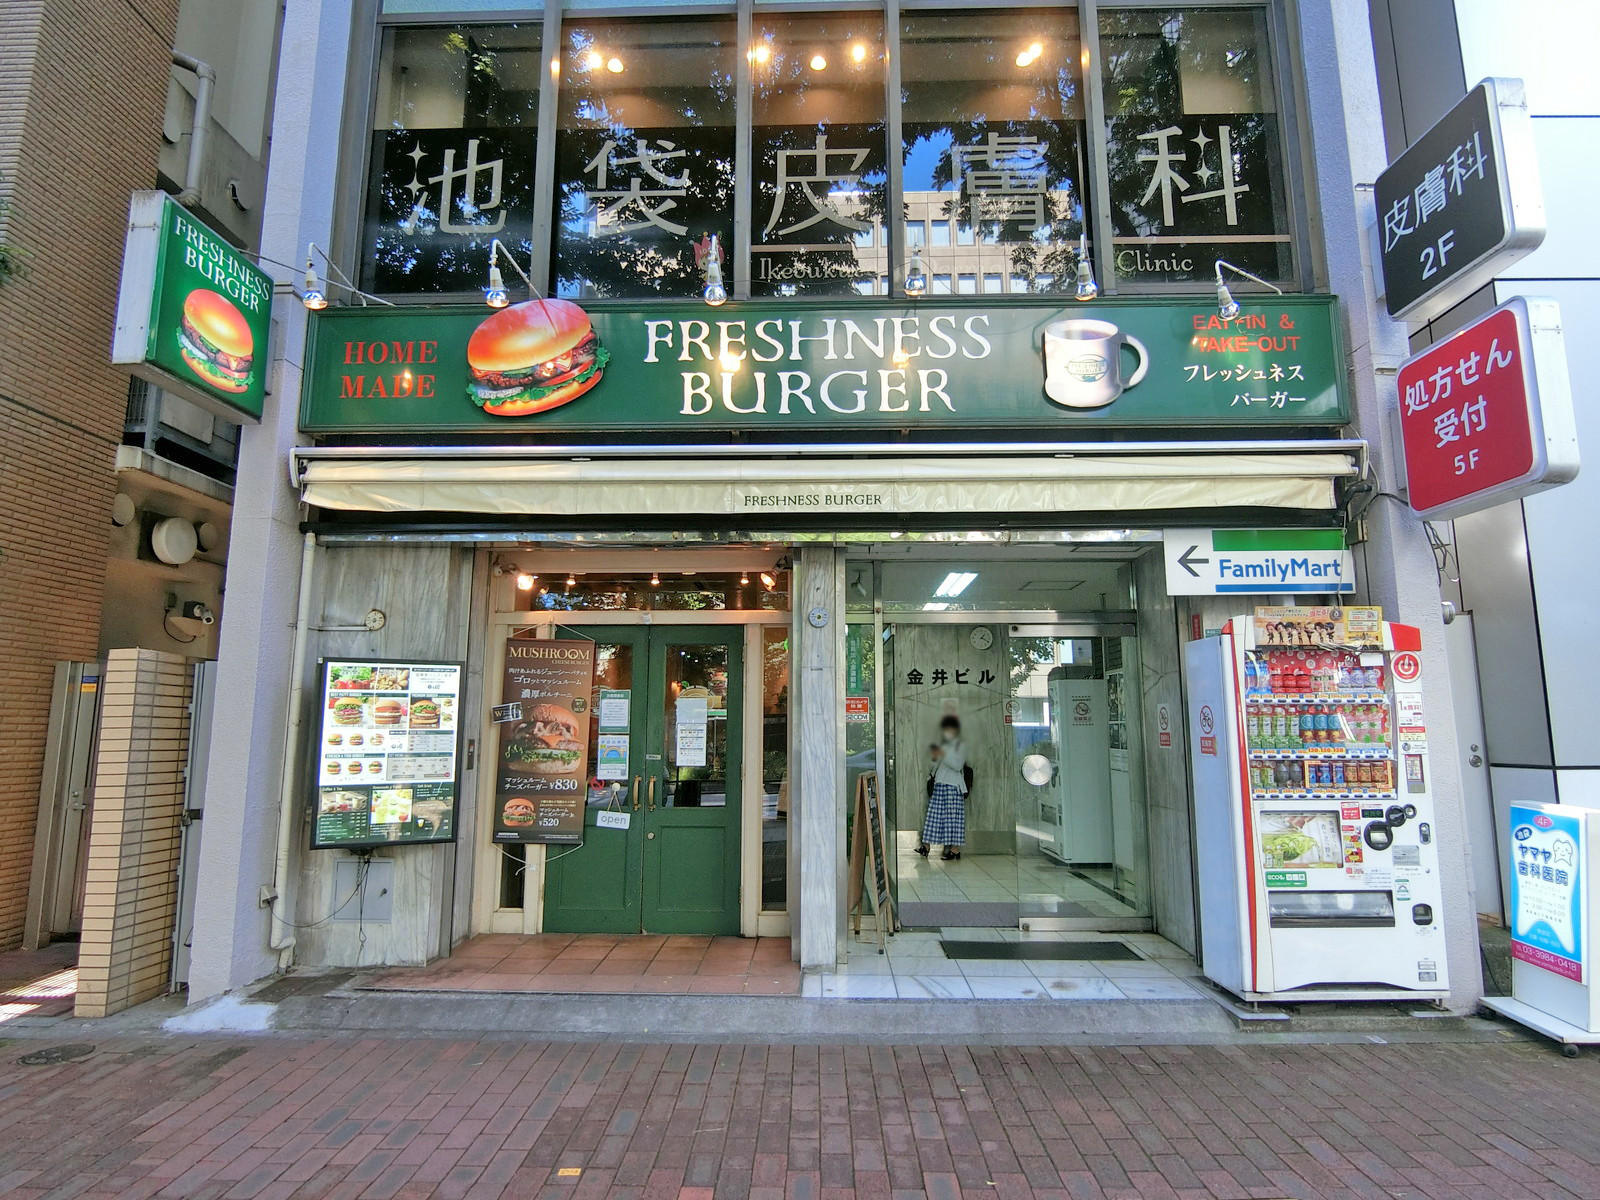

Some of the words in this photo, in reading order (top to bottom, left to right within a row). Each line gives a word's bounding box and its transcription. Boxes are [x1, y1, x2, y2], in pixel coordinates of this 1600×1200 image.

[407, 126, 1250, 236] 池袋皮膚科
[1384, 131, 1488, 253] 皮膚科
[175, 215, 270, 301] FRESHNESS
[1117, 249, 1193, 273] Clinic
[1419, 230, 1456, 281] 2F
[185, 246, 259, 313] BURGER
[1279, 314, 1295, 329] &
[644, 315, 992, 363] FRESHNESS
[1196, 336, 1300, 352] TAKE-OUT
[344, 341, 438, 365] HOME
[1183, 363, 1305, 381] フレッシュネス
[1405, 338, 1513, 417] 処方せん
[339, 375, 435, 399] MADE
[680, 368, 956, 415] BURGER
[1230, 392, 1306, 409] バーガー
[1433, 394, 1487, 449] 受付
[1453, 449, 1479, 475] 5F
[744, 494, 819, 507] FRESHNESS
[824, 493, 882, 506] BURGER
[1219, 556, 1342, 582] FamilyMart
[509, 647, 591, 660] MUSHROOM
[513, 675, 582, 686] ゴロッとマッシュルーム
[906, 667, 996, 685] 金井ビル
[521, 688, 573, 699] 濃厚ポルチーニ
[504, 783, 548, 791] チーズバーガー
[549, 778, 578, 790] ¥830
[538, 818, 559, 827] ¥520
[601, 813, 626, 825] open
[1537, 817, 1549, 826] 4F
[1518, 843, 1552, 864] ヤマヤ
[1518, 860, 1569, 887] 歯科医院
[1522, 945, 1577, 971] 03-3984-0418
